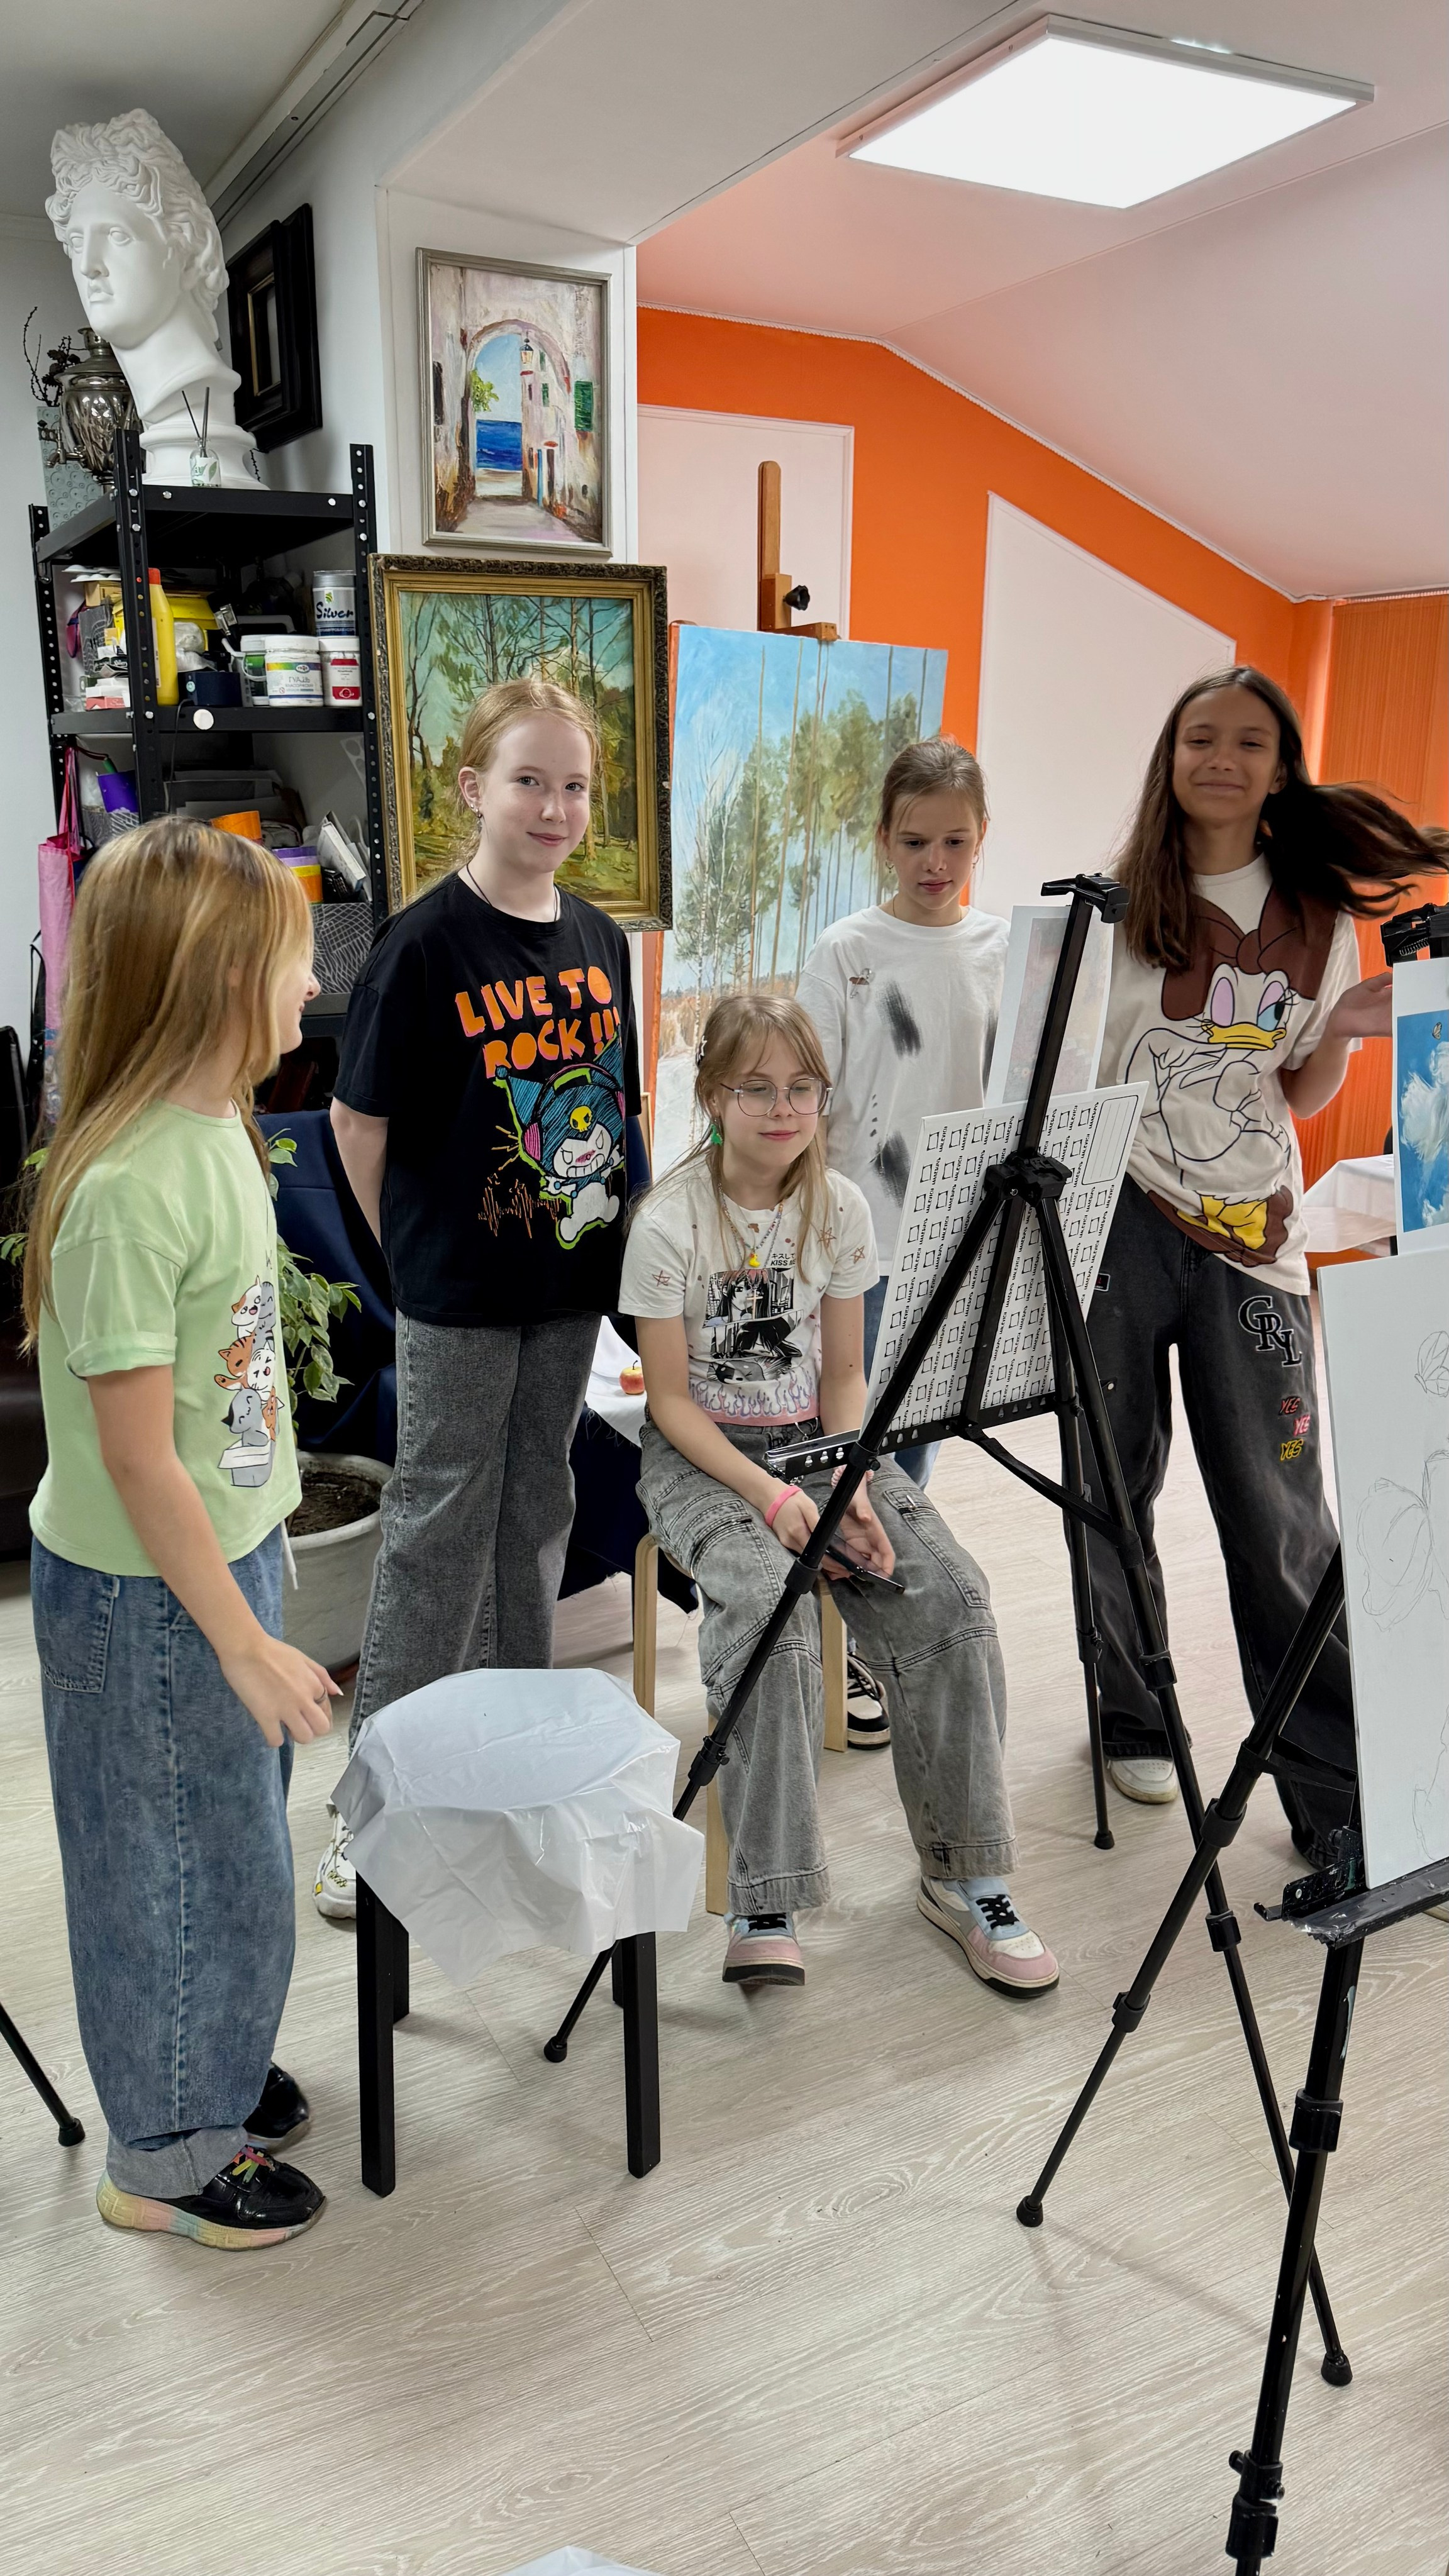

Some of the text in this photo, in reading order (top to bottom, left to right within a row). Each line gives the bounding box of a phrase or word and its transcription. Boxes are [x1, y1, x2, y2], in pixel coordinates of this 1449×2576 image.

[316, 602, 353, 619] Silver
[455, 966, 613, 1037] LIVE TO
[1280, 1438, 1304, 1461] YES
